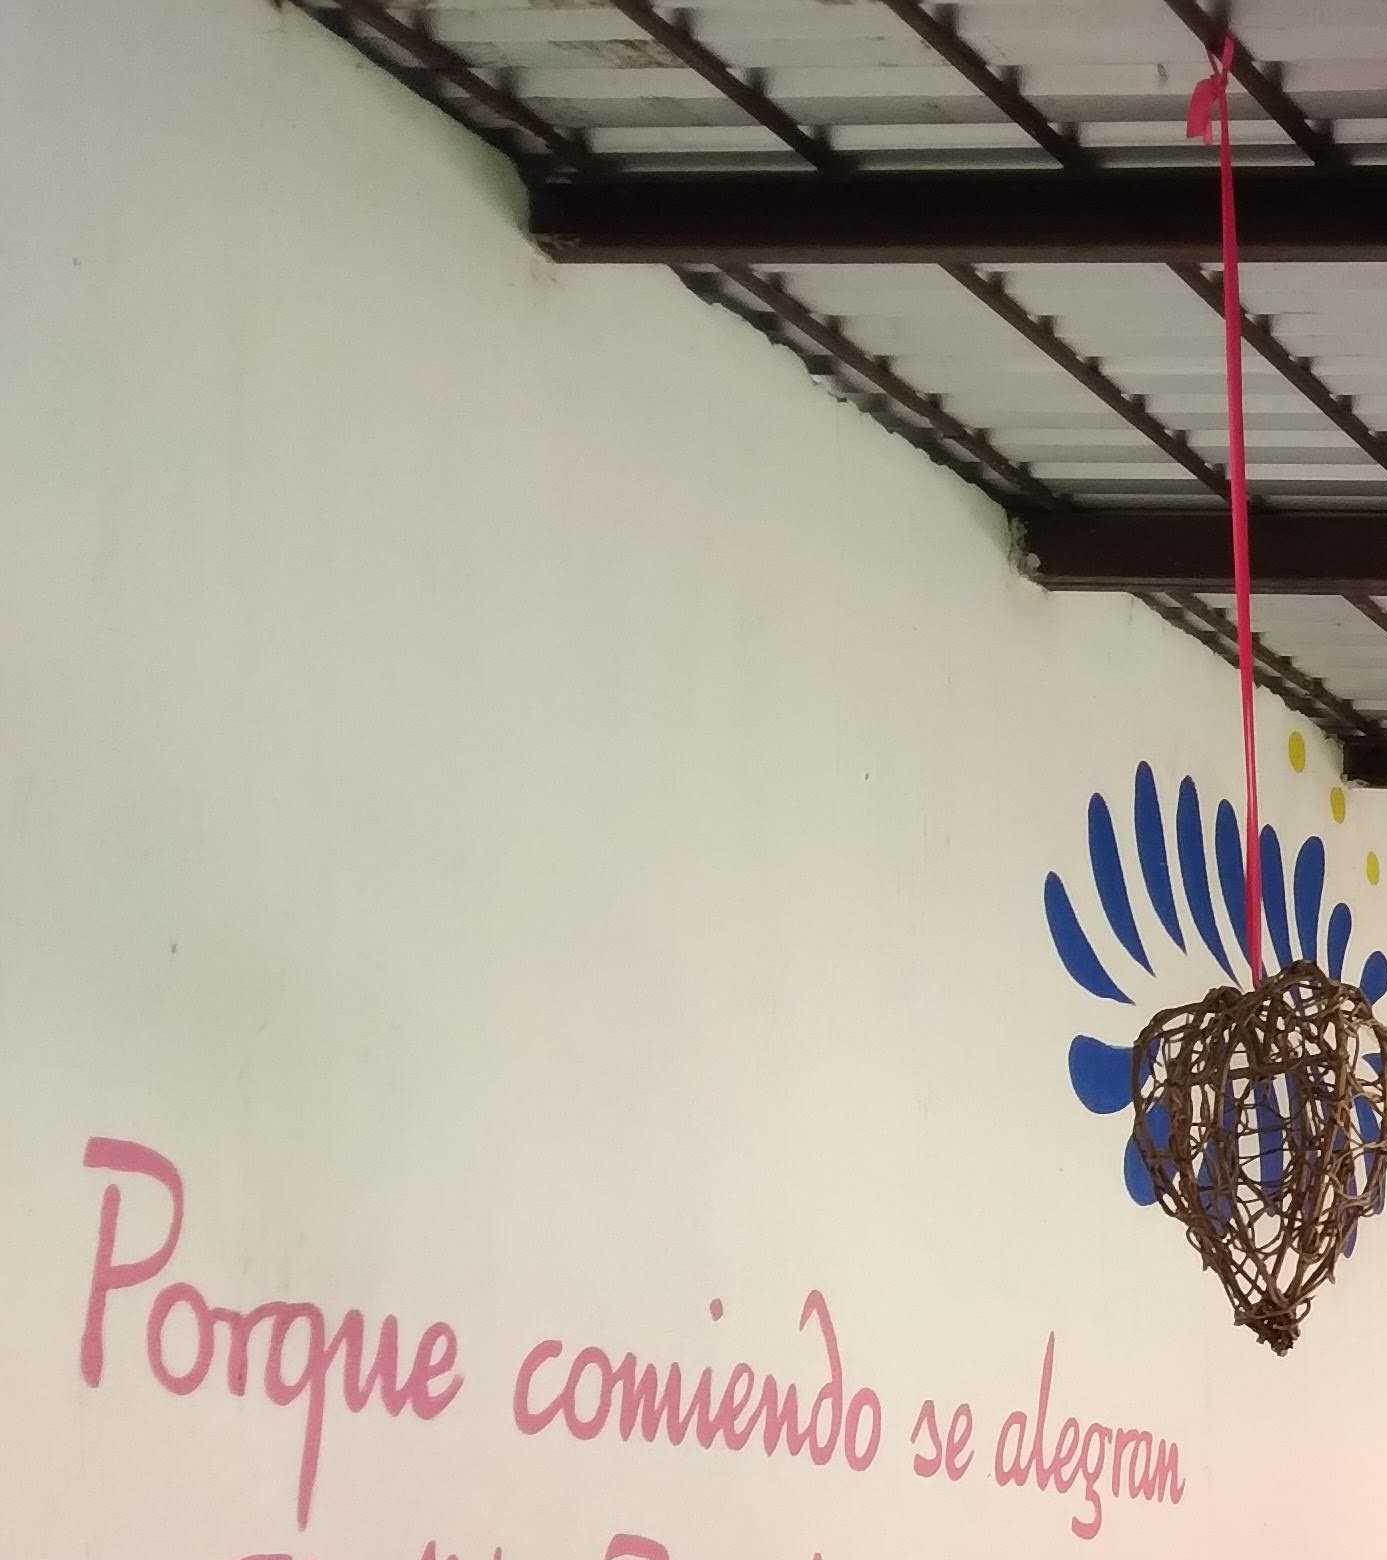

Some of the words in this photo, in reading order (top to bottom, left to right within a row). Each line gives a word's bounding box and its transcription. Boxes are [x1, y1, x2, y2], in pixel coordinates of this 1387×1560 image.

[80, 1136, 464, 1531] Porque
[513, 1289, 882, 1472] comiendo
[910, 1402, 974, 1481] se
[994, 1331, 1187, 1540] alegran
